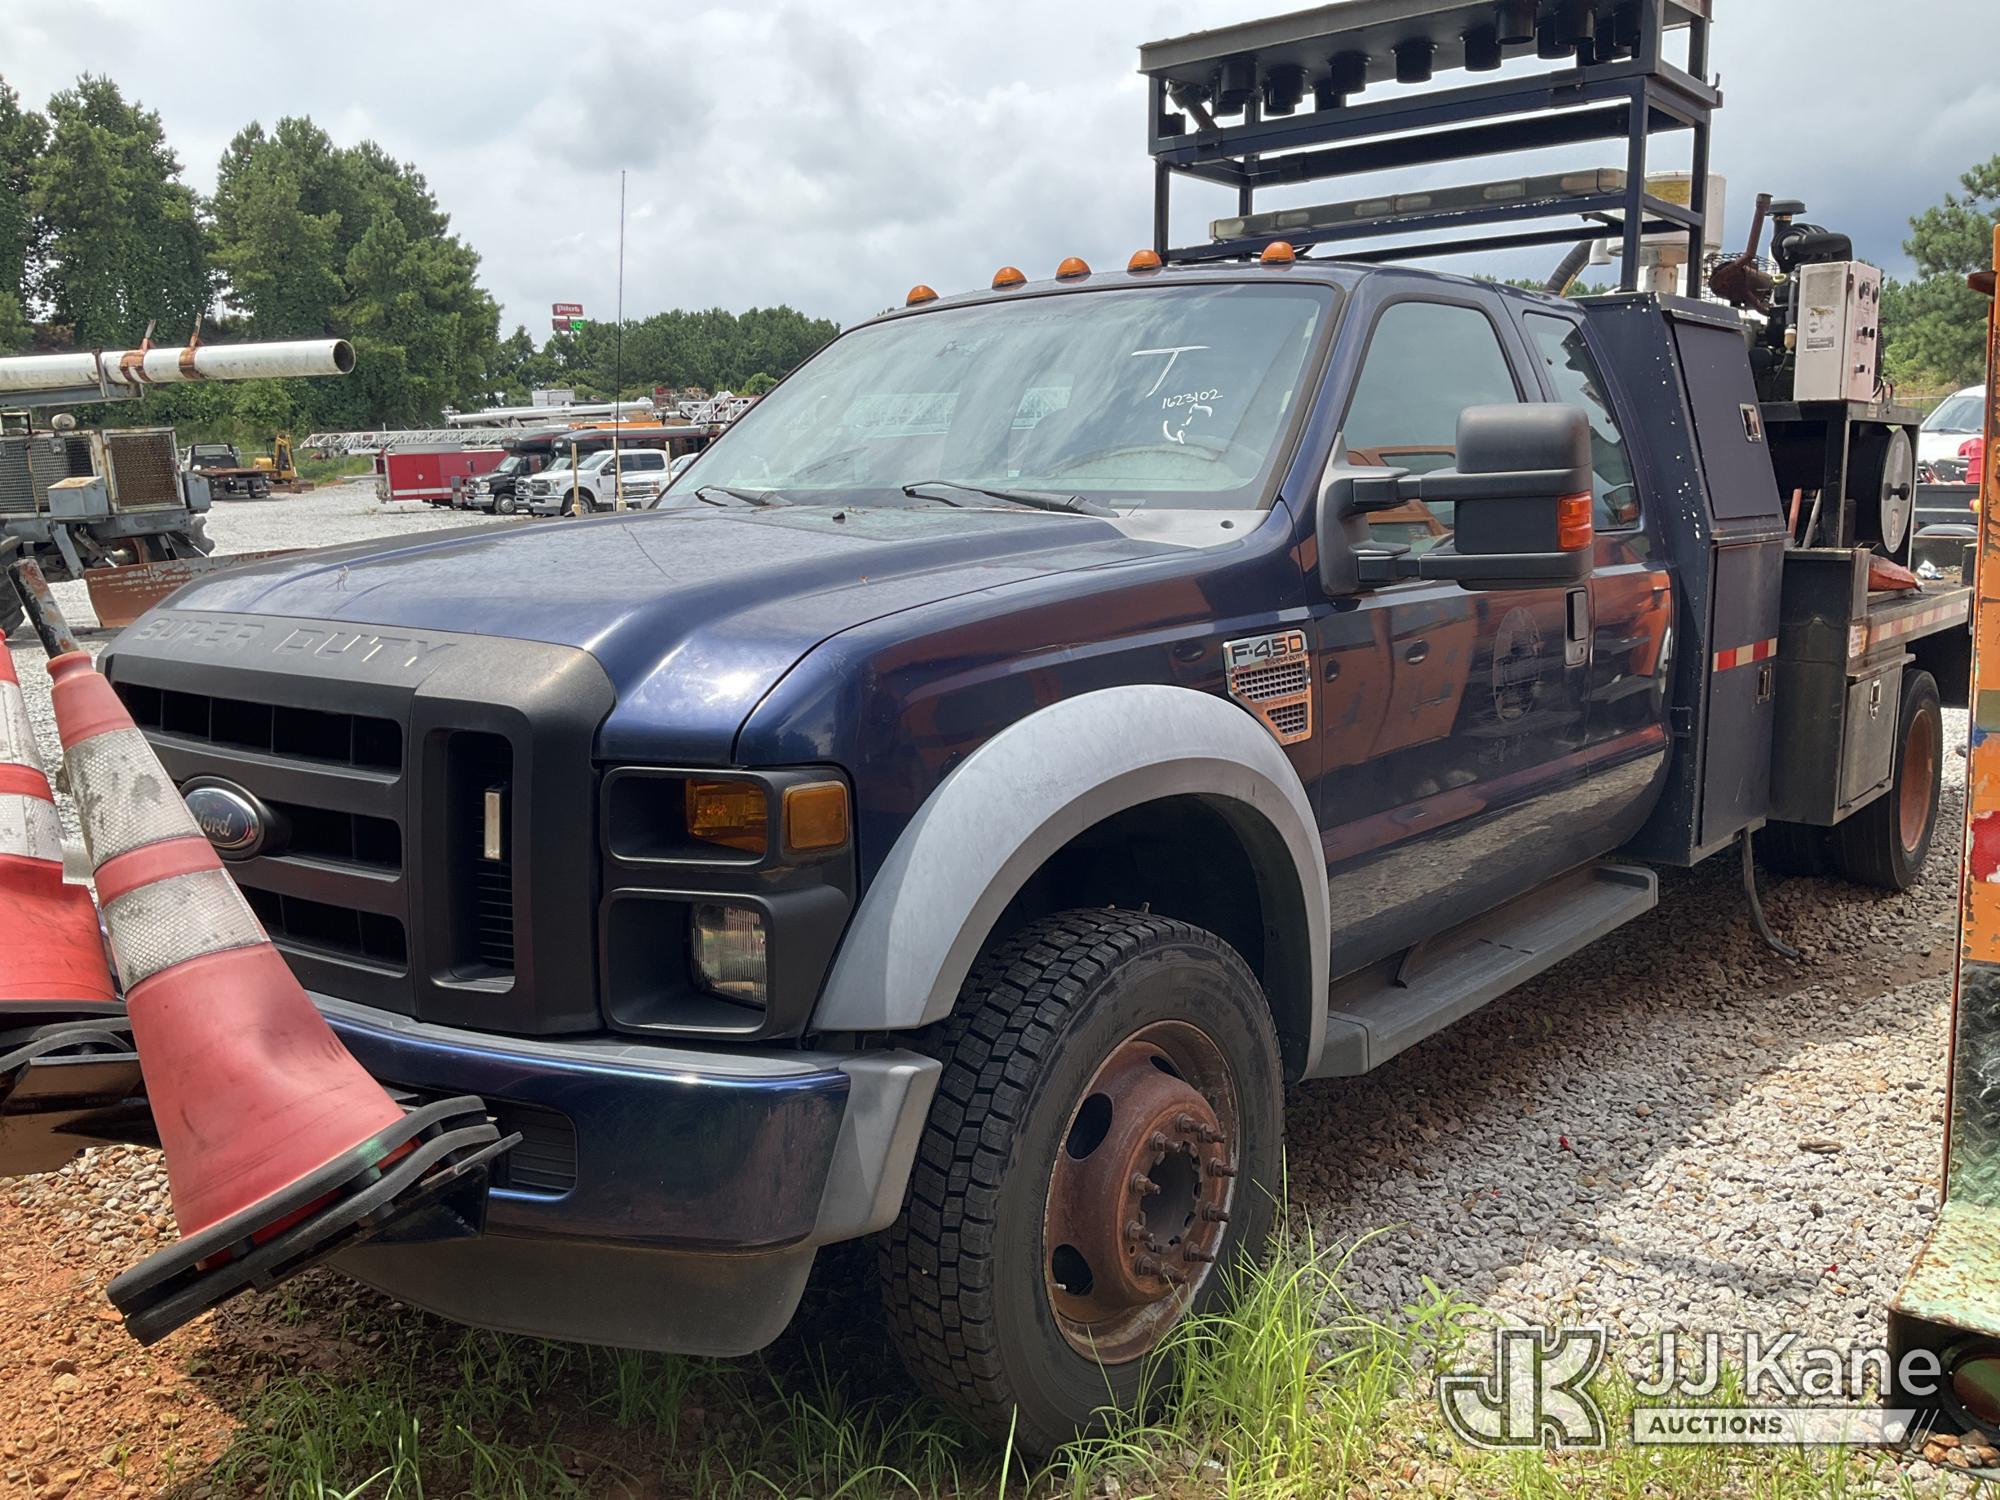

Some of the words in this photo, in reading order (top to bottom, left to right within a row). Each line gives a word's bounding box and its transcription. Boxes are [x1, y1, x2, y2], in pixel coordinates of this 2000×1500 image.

[1161, 388, 1225, 410] 1623102
[133, 617, 264, 652] SUPER
[272, 628, 457, 668] DUTY
